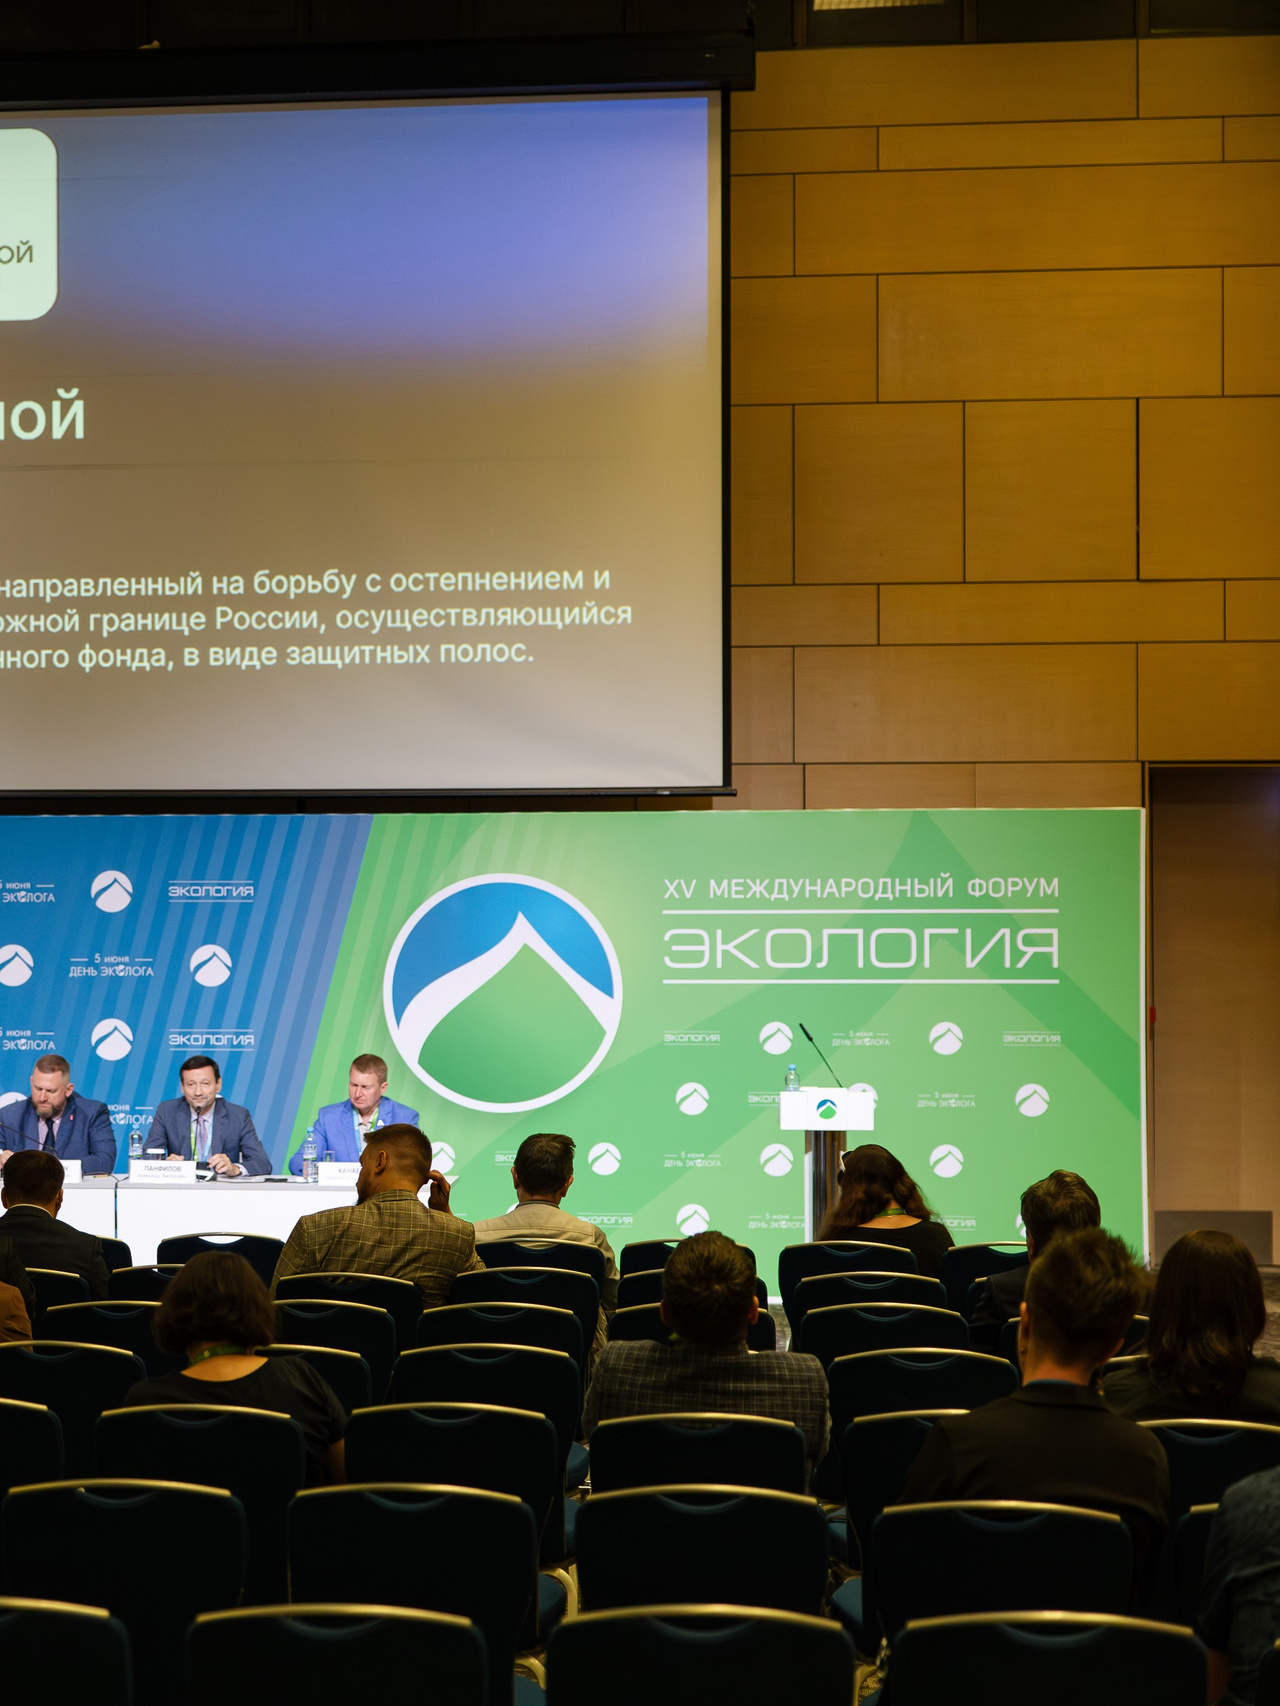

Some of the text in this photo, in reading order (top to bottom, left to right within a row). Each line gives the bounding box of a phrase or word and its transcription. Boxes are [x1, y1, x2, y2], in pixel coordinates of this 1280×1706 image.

[213, 576, 244, 594] на
[254, 569, 356, 599] борьбу
[366, 574, 381, 592] с
[390, 570, 583, 591] остепнением
[594, 570, 609, 589] и
[90, 612, 206, 637] границе
[216, 607, 325, 634] России,
[336, 601, 632, 634] осуществляющийся
[78, 644, 173, 672] фонда,
[184, 648, 199, 666] в
[210, 647, 277, 670] виде
[287, 645, 430, 669] защитных
[441, 643, 533, 662] полос.
[168, 885, 255, 898] ЭКОЛОГИЯ
[664, 873, 1058, 901] XV МЕЖДУНАРОДНЫЙ ФОРУМ
[663, 928, 1058, 969] ЭКОЛОГИЯ
[95, 953, 101, 963] 5
[69, 967, 97, 977] ДЕНЬ
[168, 1034, 255, 1047] ЭКОЛОГИЯ
[663, 1033, 720, 1042] ЭКОЛОГИЯ
[1002, 1034, 1061, 1044] ЭКОЛОГИЯ
